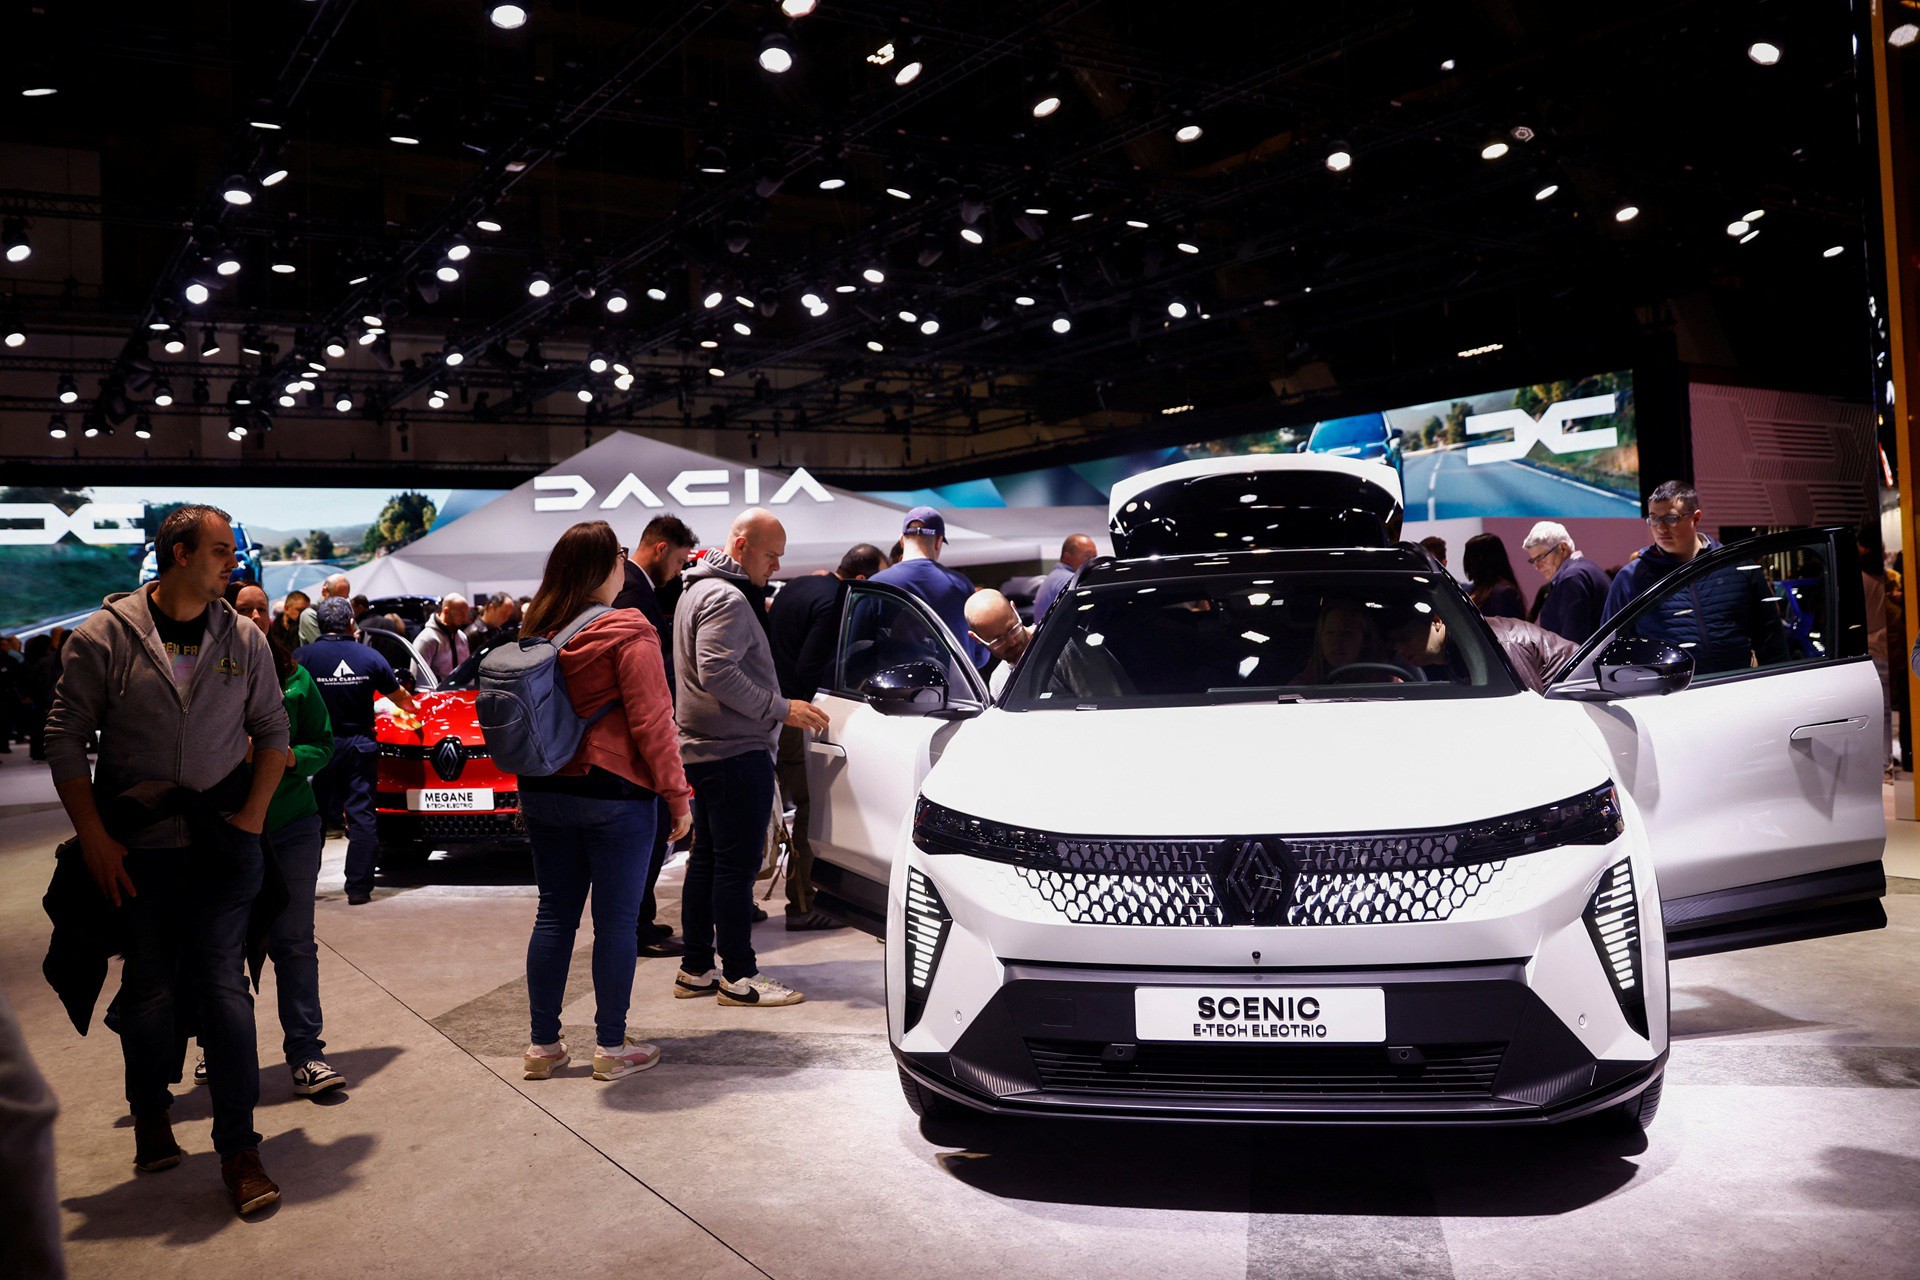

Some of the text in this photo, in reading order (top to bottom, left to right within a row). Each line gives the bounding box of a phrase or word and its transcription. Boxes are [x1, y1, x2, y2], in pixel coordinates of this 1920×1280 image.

[534, 467, 835, 511] DACIA
[425, 793, 473, 801] MEGANE
[1198, 996, 1320, 1021] SCENIC
